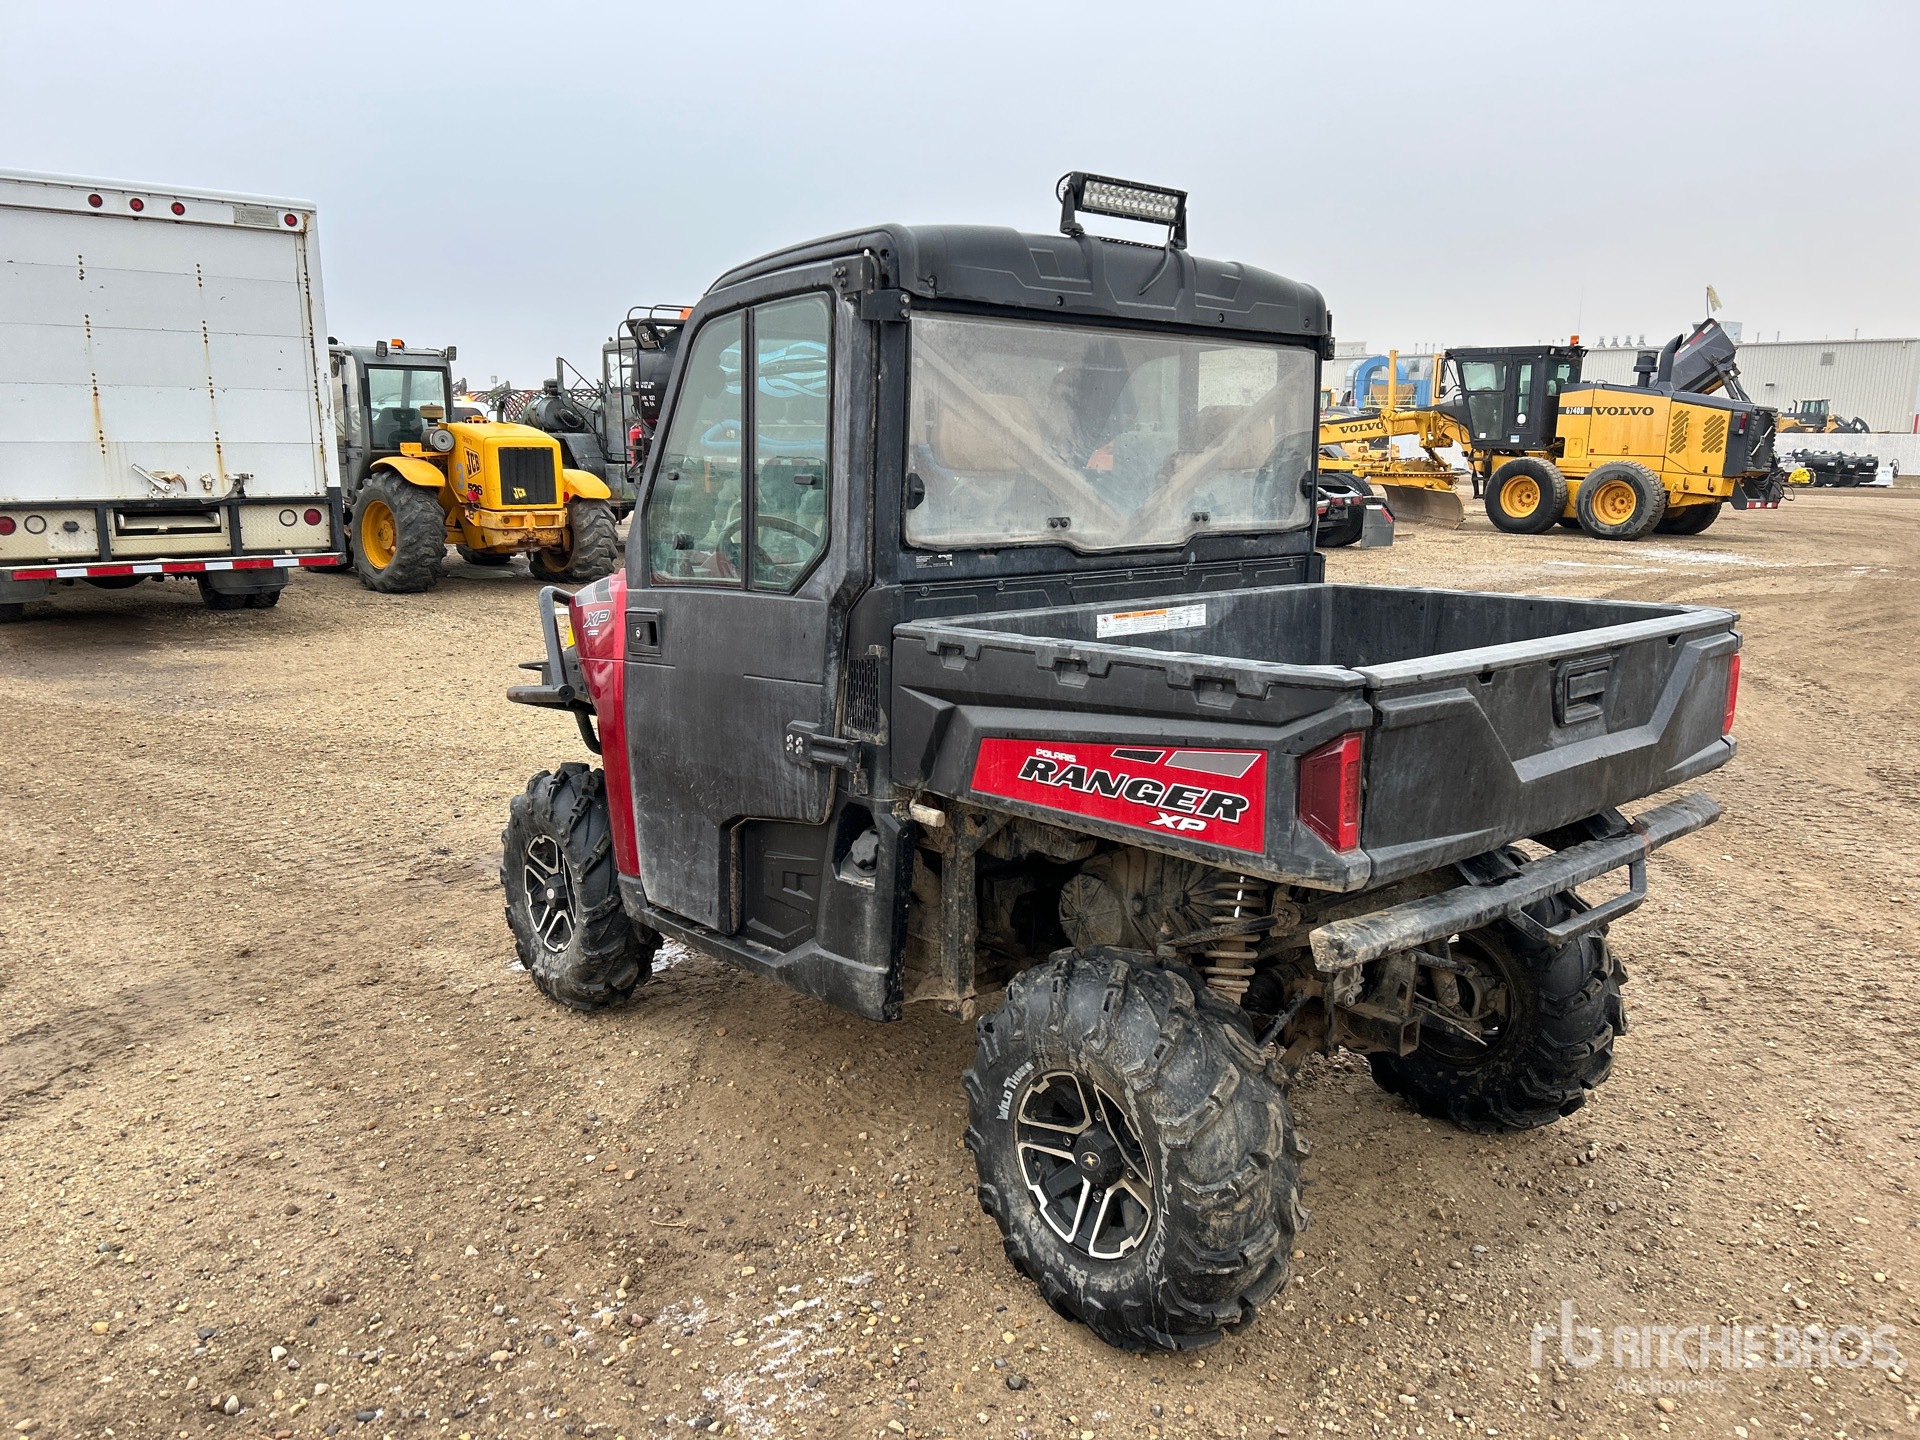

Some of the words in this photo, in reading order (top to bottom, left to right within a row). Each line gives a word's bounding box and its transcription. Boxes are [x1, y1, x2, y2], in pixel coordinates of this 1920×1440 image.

[1594, 406, 1655, 416] VOLVO
[466, 450, 480, 477] JCB
[456, 462, 465, 490] 3
[468, 483, 483, 495] 526
[583, 609, 610, 628] XP
[1035, 748, 1076, 763] POLARIS
[1018, 755, 1250, 823] RANGER
[1149, 811, 1207, 831] XP
[996, 1089, 1013, 1120] WILD
